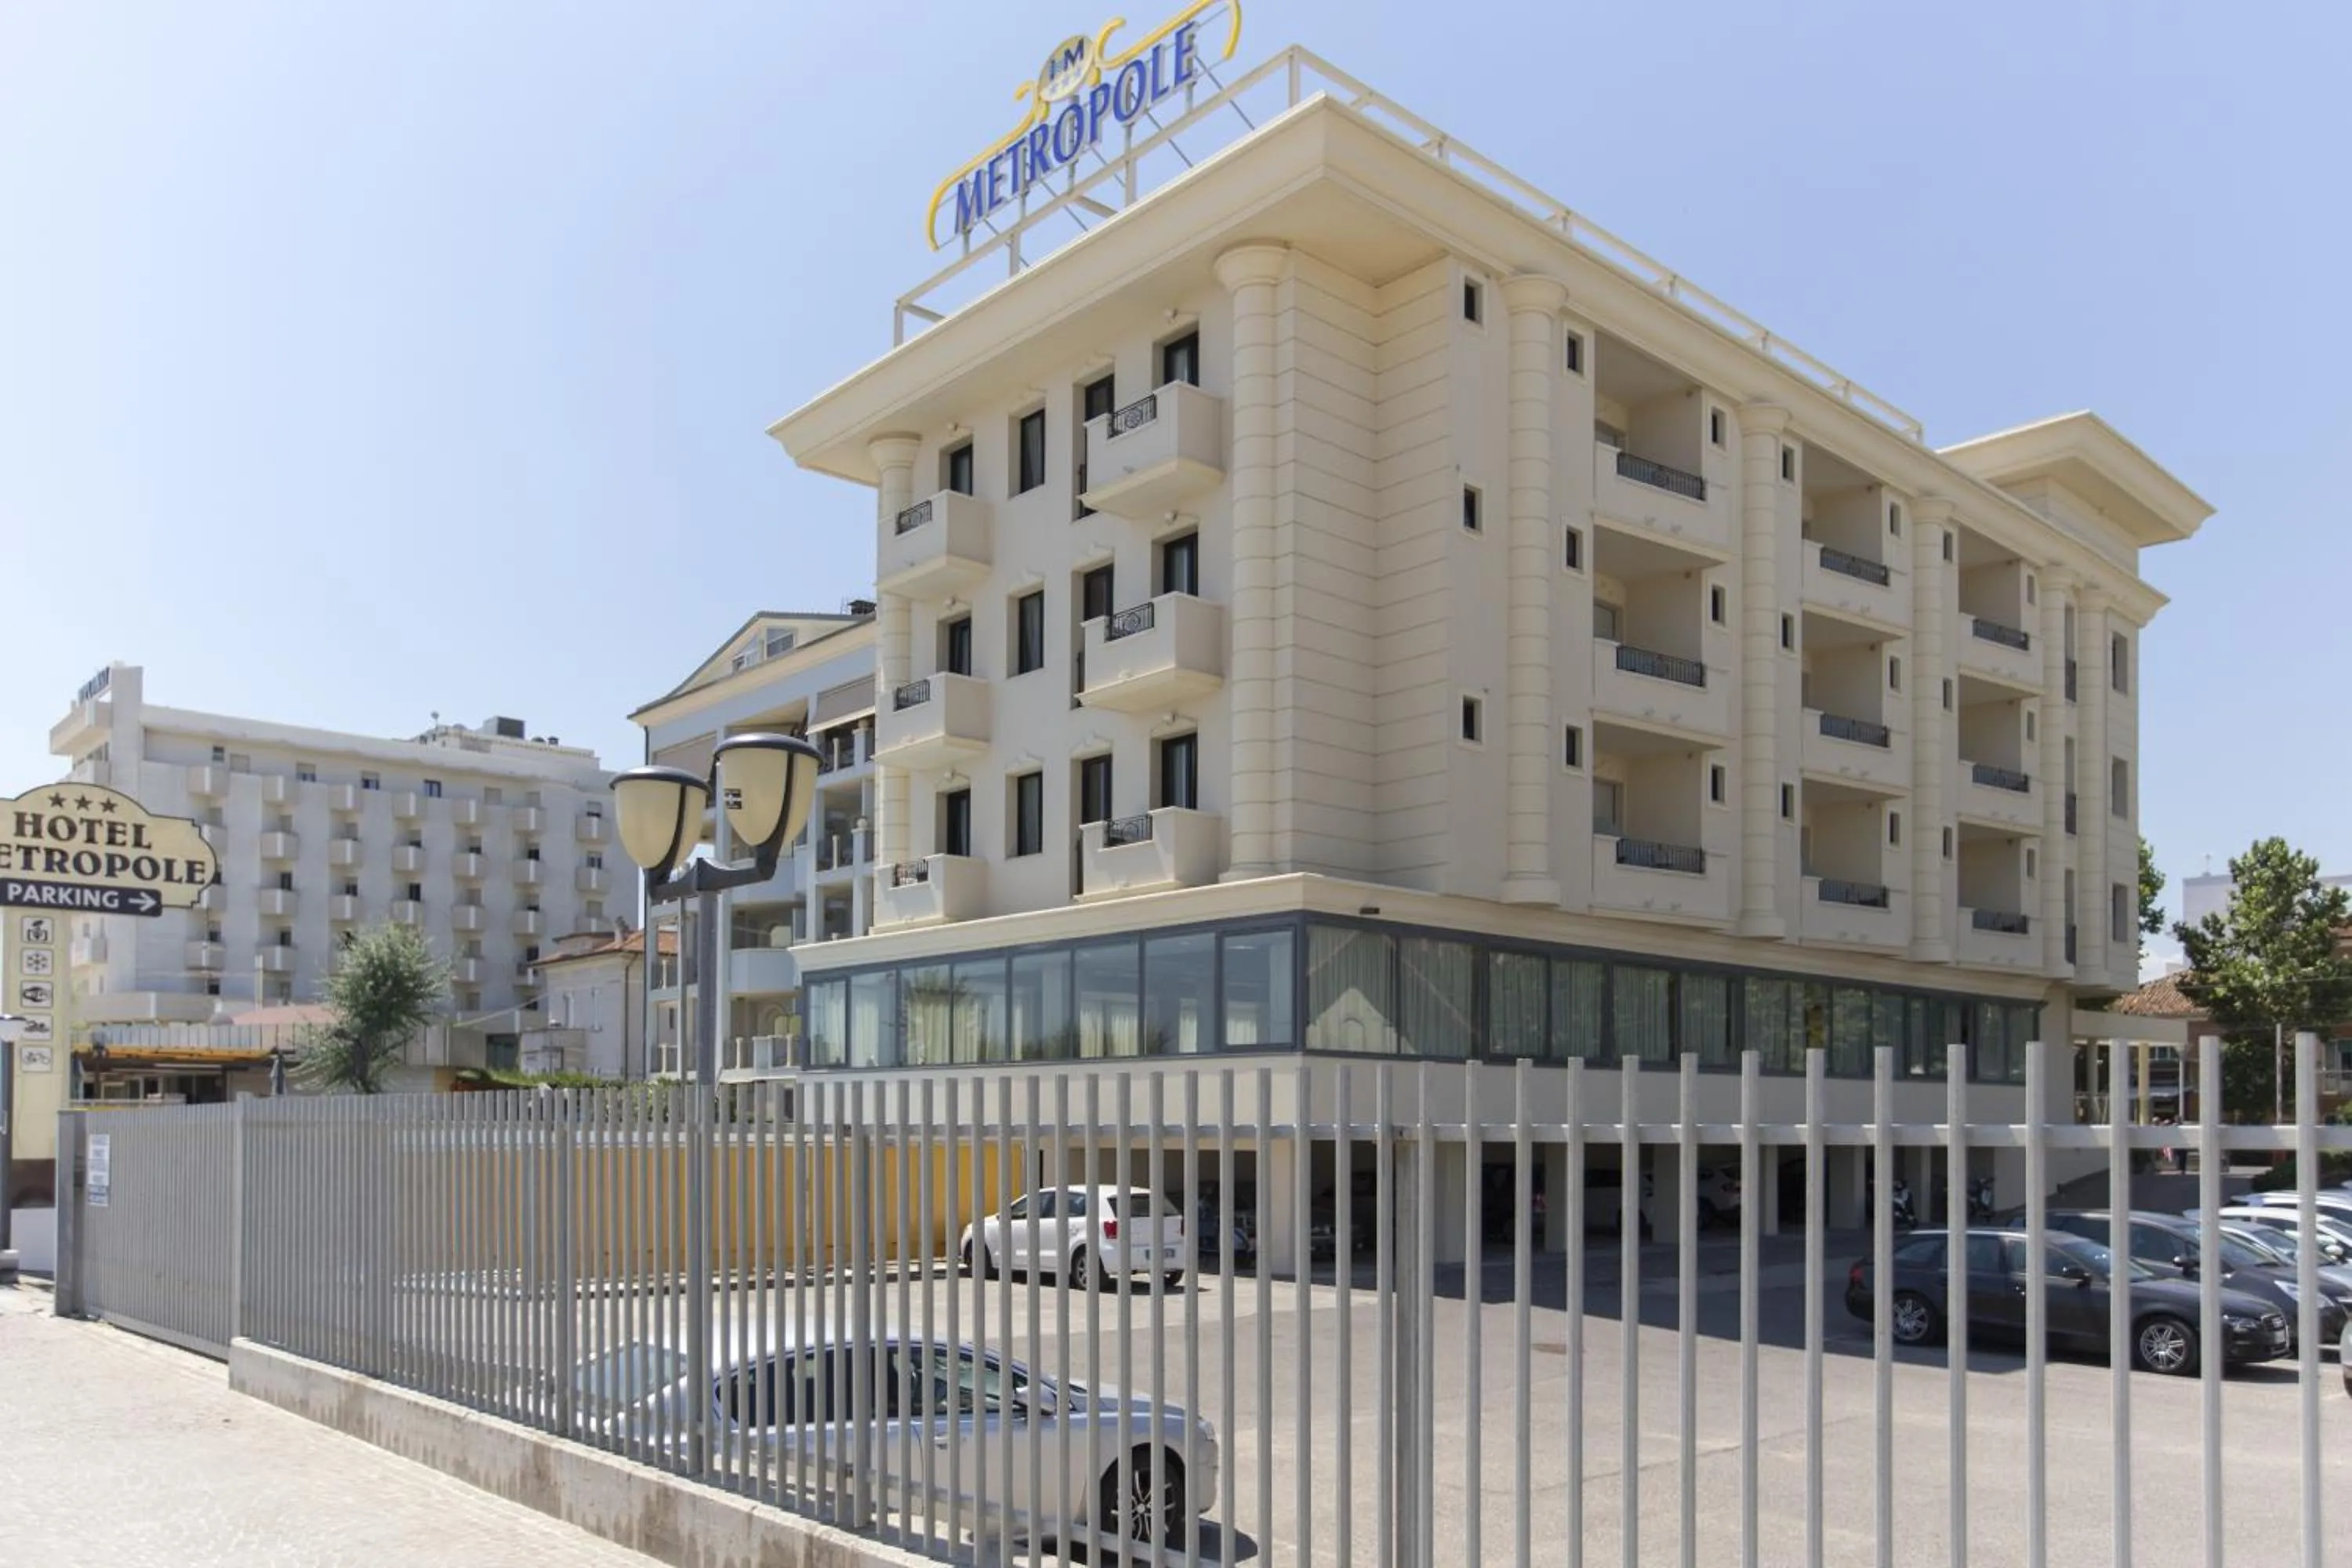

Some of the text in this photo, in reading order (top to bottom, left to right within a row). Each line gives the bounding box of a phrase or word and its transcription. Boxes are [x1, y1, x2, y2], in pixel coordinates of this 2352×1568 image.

[954, 20, 1197, 236] METROPOLE
[13, 811, 152, 850] HOTEL
[7, 883, 119, 909] PARKING
